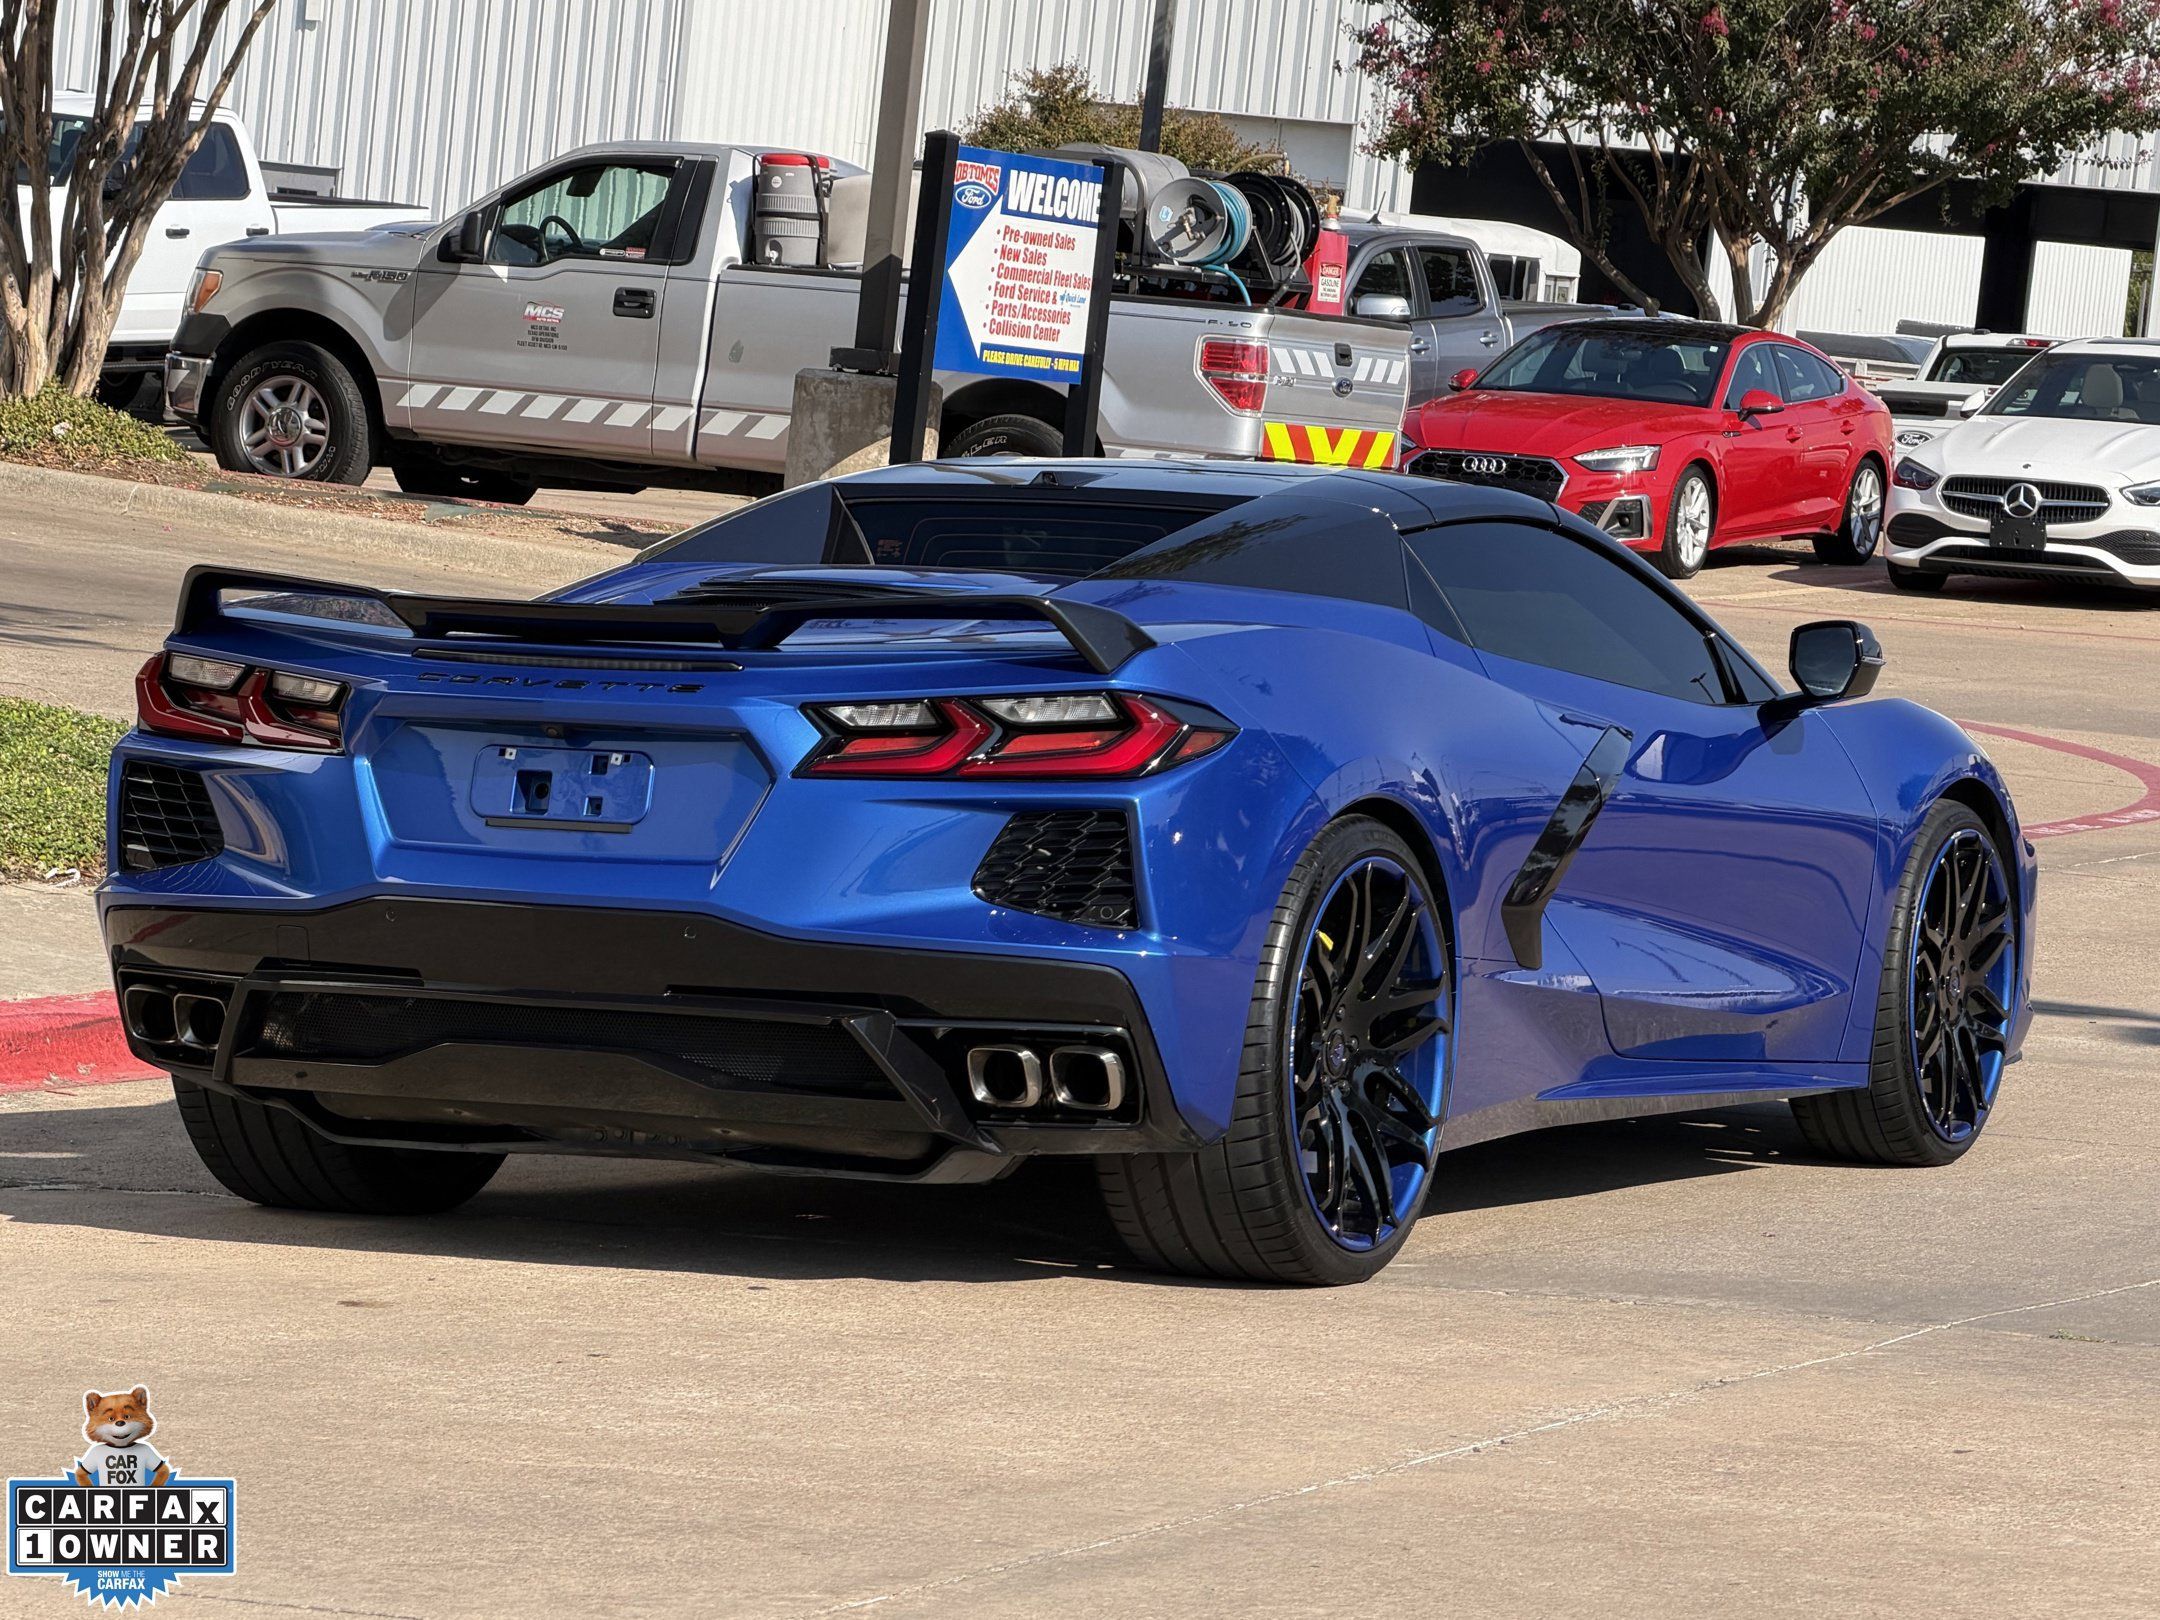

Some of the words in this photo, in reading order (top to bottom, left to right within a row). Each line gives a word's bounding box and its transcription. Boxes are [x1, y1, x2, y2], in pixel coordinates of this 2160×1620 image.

[961, 188, 985, 205] Ford
[1007, 169, 1102, 223] WELCOME
[1002, 225, 1053, 249] Pre-owned
[1054, 232, 1076, 251] Sales
[999, 244, 1021, 263] New
[1022, 247, 1048, 266] Sales
[996, 263, 1053, 286] Commercial
[1054, 271, 1073, 288] Fleet
[1073, 273, 1092, 291] Sales
[1320, 278, 1340, 288] GASOLINE
[993, 281, 1016, 300] Ford
[1017, 284, 1051, 305] Service
[1052, 291, 1058, 305] &
[523, 303, 565, 320] MCS
[991, 300, 1072, 326] Parts/Accessories
[988, 318, 1031, 339] Collision
[1033, 324, 1061, 342] Center
[982, 349, 1006, 364] PLEASE
[1901, 433, 1926, 445] Ford
[416, 671, 707, 693] CORVETTE
